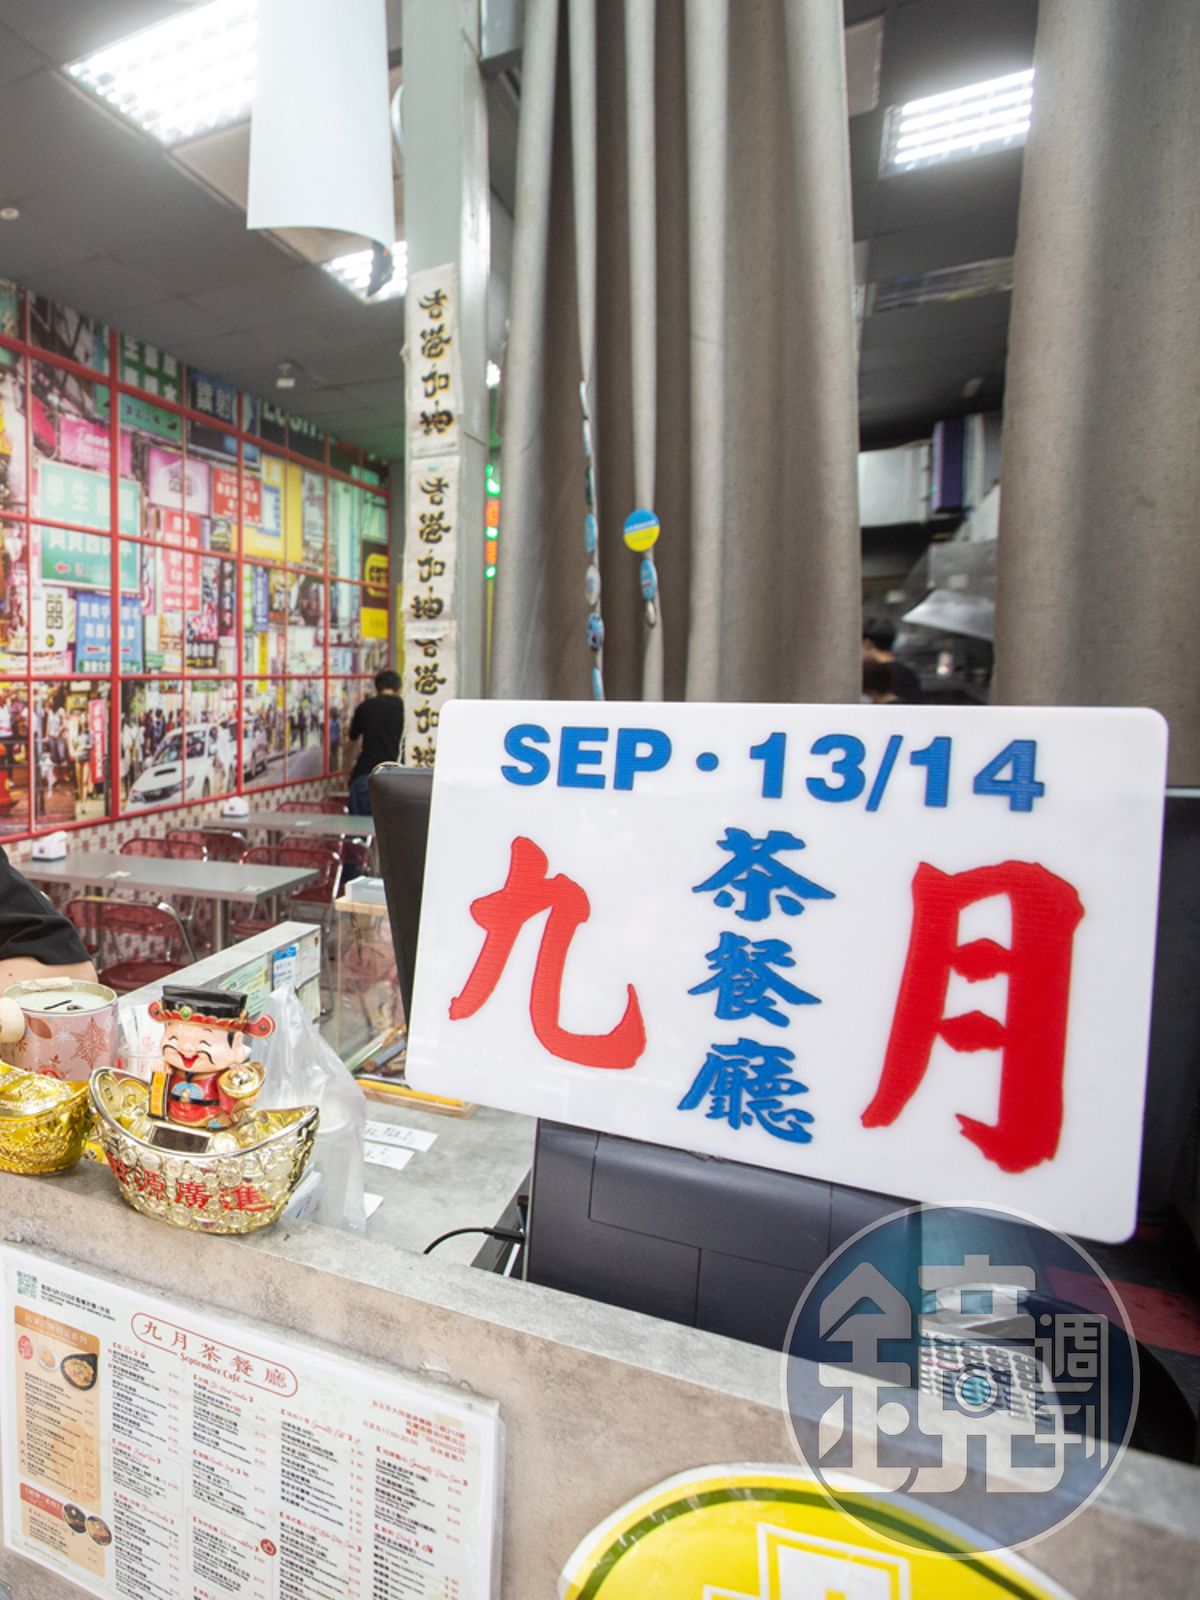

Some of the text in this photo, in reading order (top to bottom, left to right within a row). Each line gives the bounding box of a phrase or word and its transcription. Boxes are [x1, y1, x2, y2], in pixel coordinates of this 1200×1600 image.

[501, 724, 673, 792] SEP
[750, 732, 1045, 812] 13/14
[677, 827, 836, 1145] 茶餐廳
[141, 1321, 288, 1389] 九月茶餐廳
